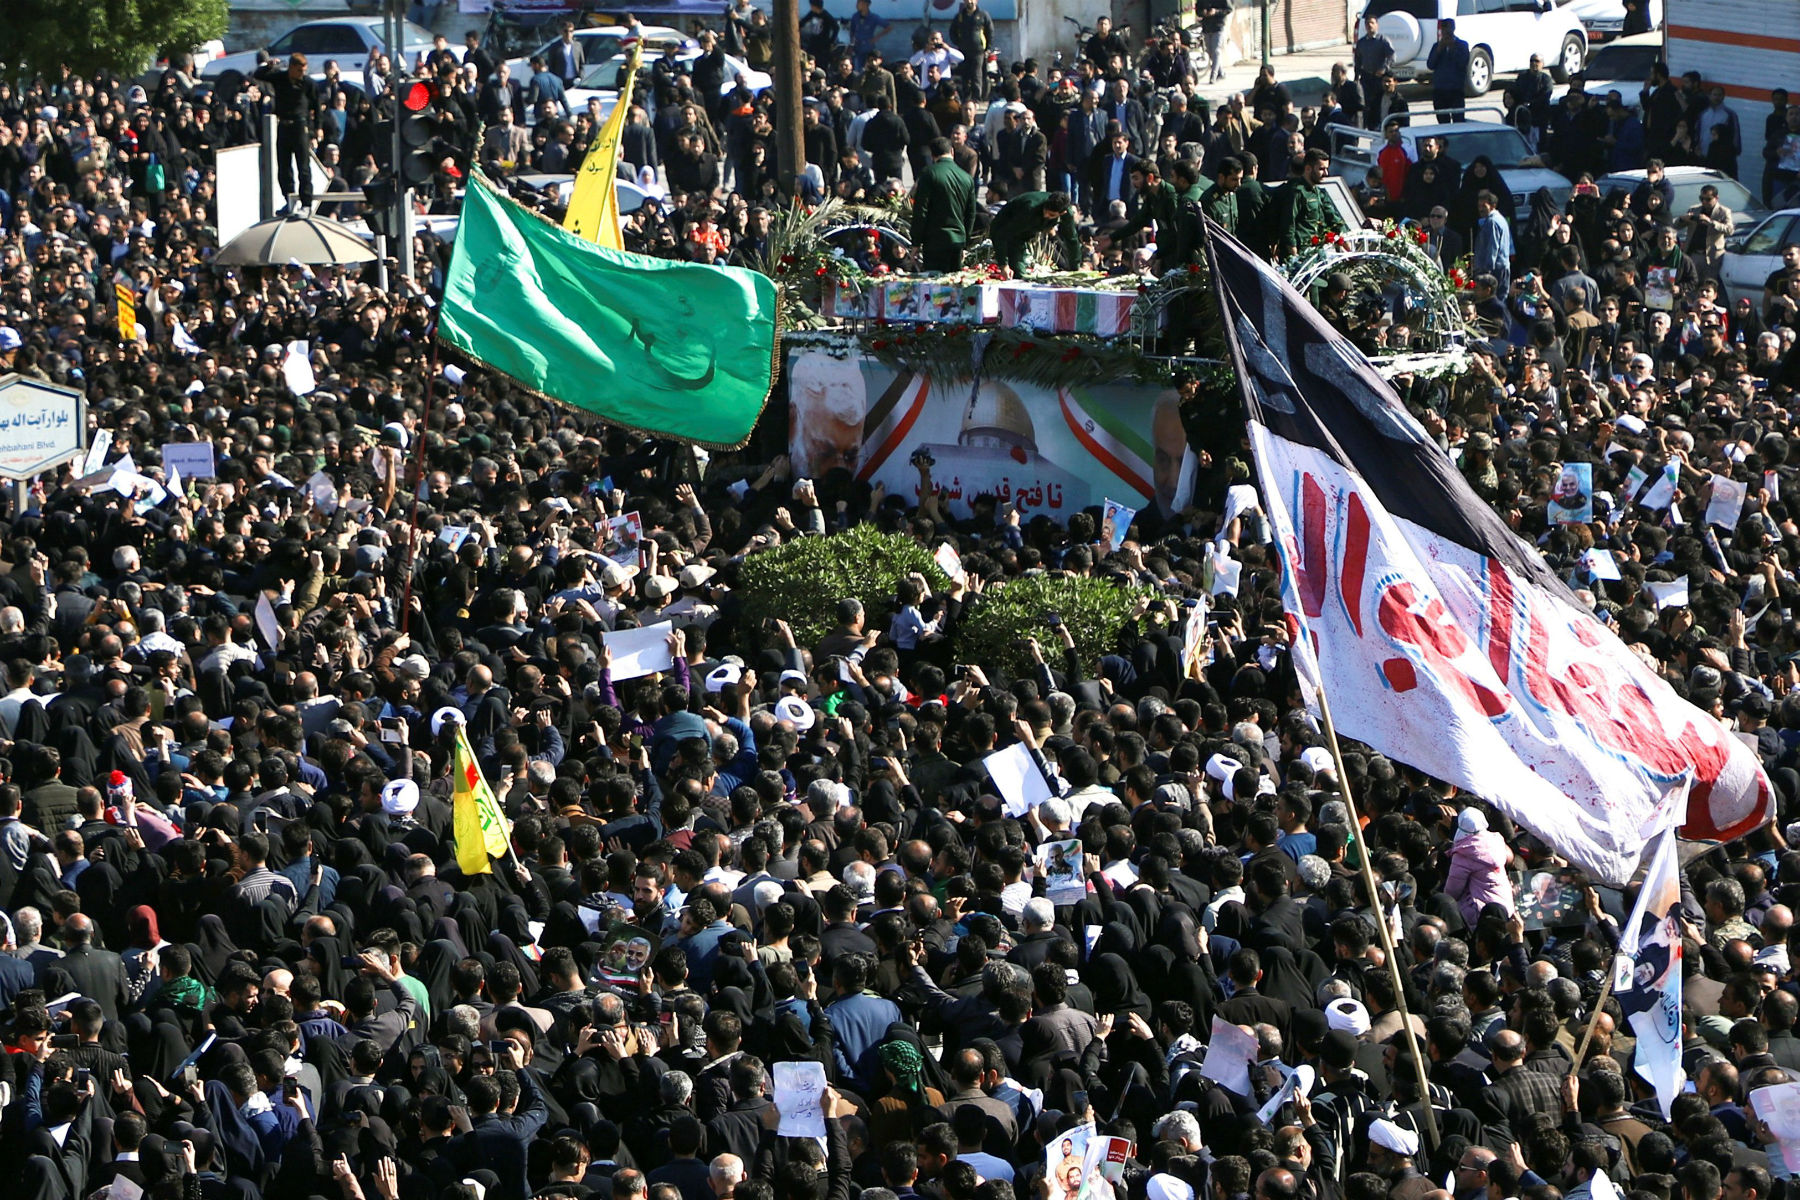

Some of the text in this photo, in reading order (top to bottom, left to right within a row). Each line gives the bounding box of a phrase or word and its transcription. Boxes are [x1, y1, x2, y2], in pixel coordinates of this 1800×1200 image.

[27, 408, 48, 430] آیت
[45, 409, 68, 428] بلوار
[1016, 480, 1043, 514] فتح
[1047, 482, 1062, 509] تا
